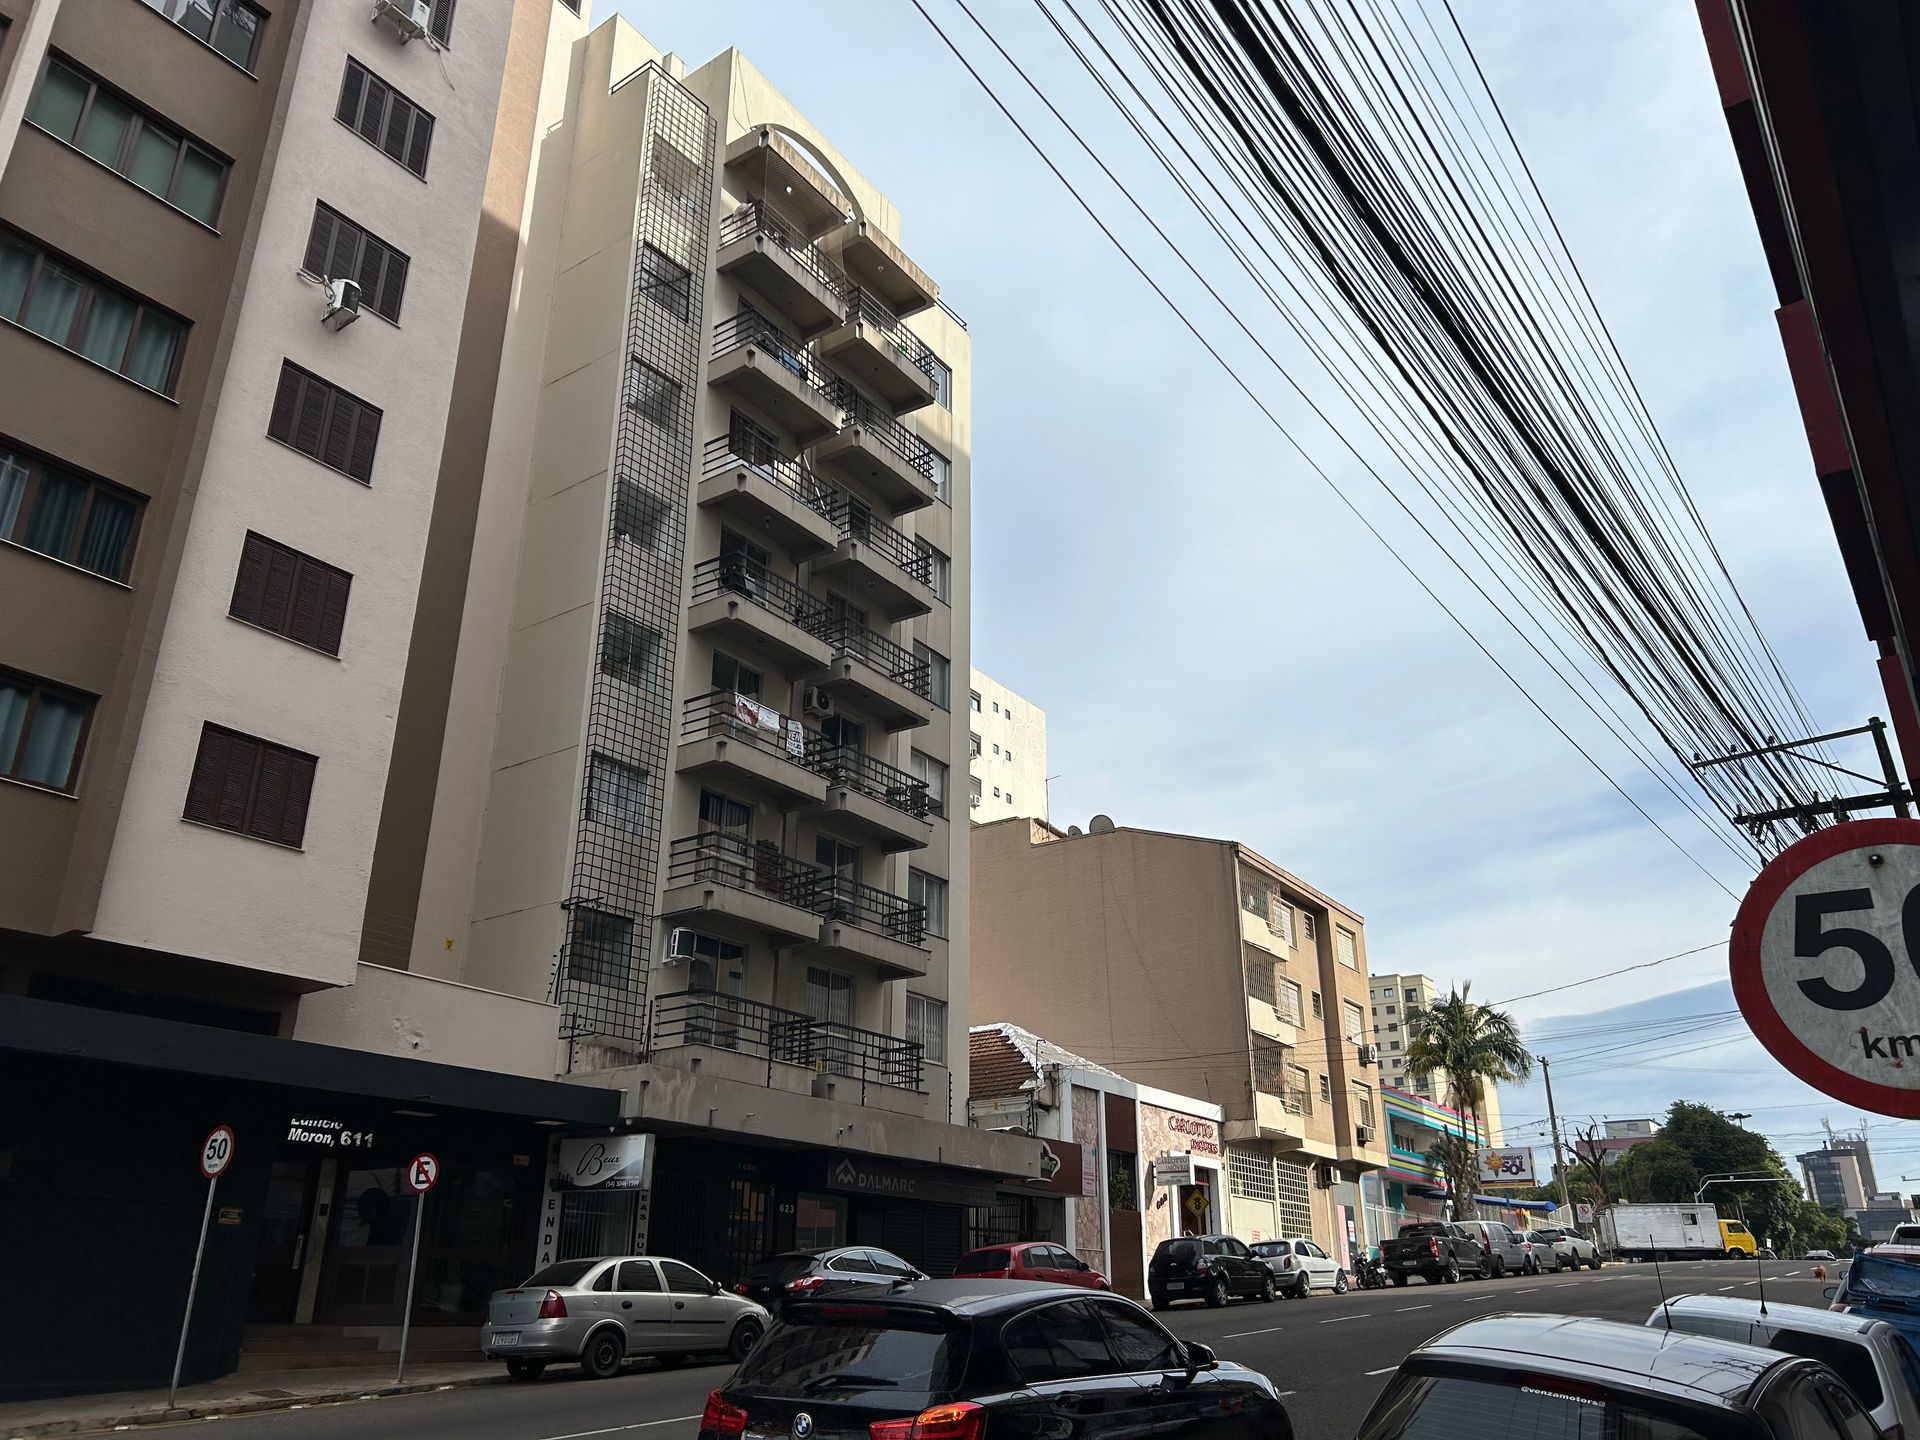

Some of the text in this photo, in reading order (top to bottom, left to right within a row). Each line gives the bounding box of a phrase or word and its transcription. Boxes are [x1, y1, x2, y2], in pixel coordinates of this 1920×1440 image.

[1794, 882, 1920, 1010] 5
[287, 1126, 374, 1149] Moron, 611
[1167, 1115, 1214, 1139] CARLOTTO
[206, 1137, 229, 1161] 50
[575, 1142, 622, 1176] Beux
[1156, 1156, 1188, 1165] CARLOTTO
[858, 1172, 916, 1194] DALMARC
[779, 1204, 795, 1214] 623
